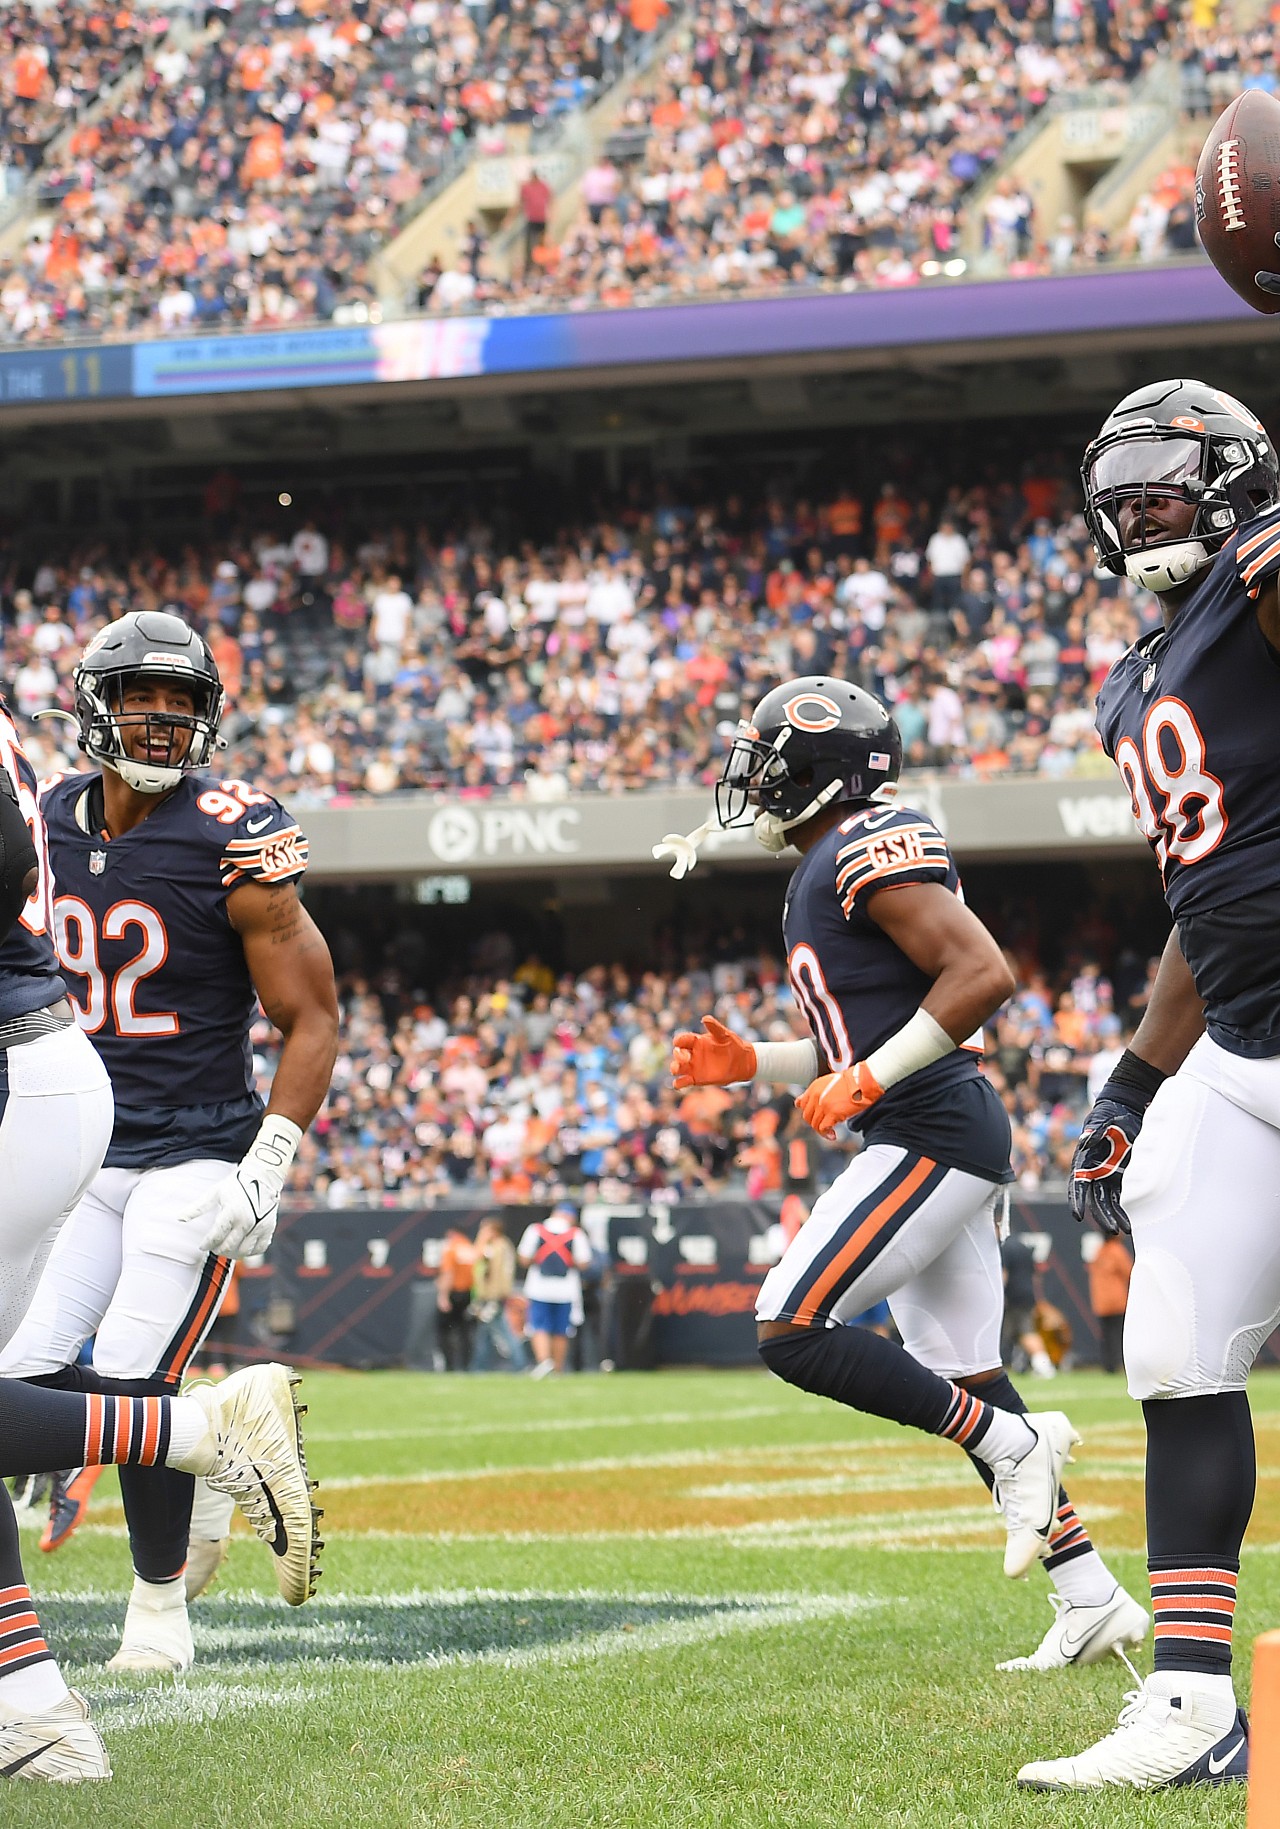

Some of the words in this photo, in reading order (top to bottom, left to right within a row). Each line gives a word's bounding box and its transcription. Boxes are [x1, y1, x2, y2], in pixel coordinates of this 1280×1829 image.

[196, 779, 273, 825] 92
[1115, 694, 1230, 884] 98
[481, 806, 581, 855] PNC
[866, 830, 925, 870] GSH
[53, 893, 180, 1038] 92
